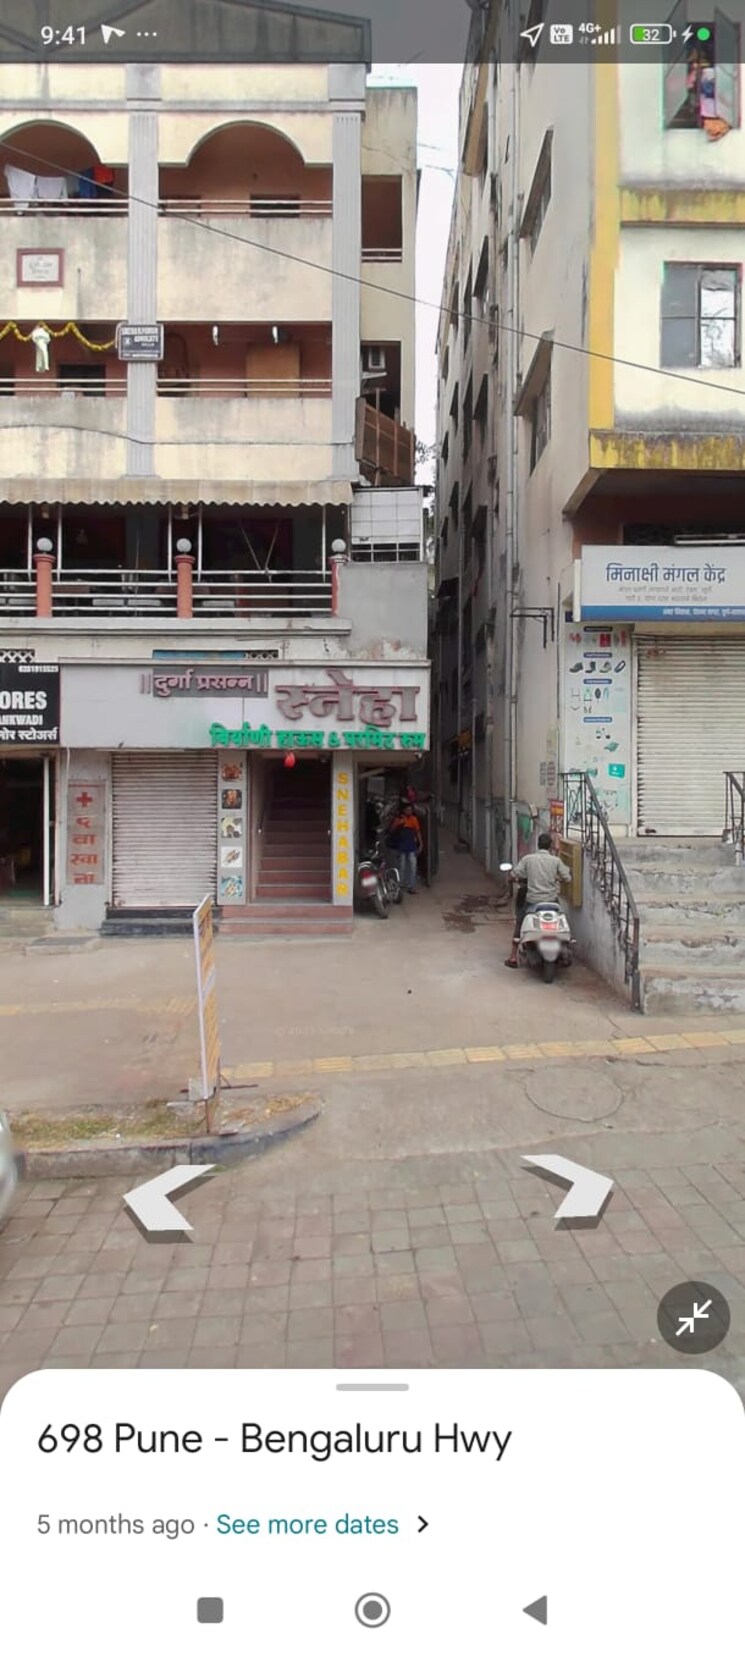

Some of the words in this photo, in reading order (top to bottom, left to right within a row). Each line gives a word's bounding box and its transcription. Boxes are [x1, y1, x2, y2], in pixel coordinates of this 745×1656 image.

[606, 562, 660, 582] मिनाक्षी
[663, 563, 701, 582] मंगल
[703, 563, 728, 584] केंद्र
[0, 690, 47, 710] ORES
[275, 669, 420, 728] स्नेहा
[328, 731, 341, 748] &
